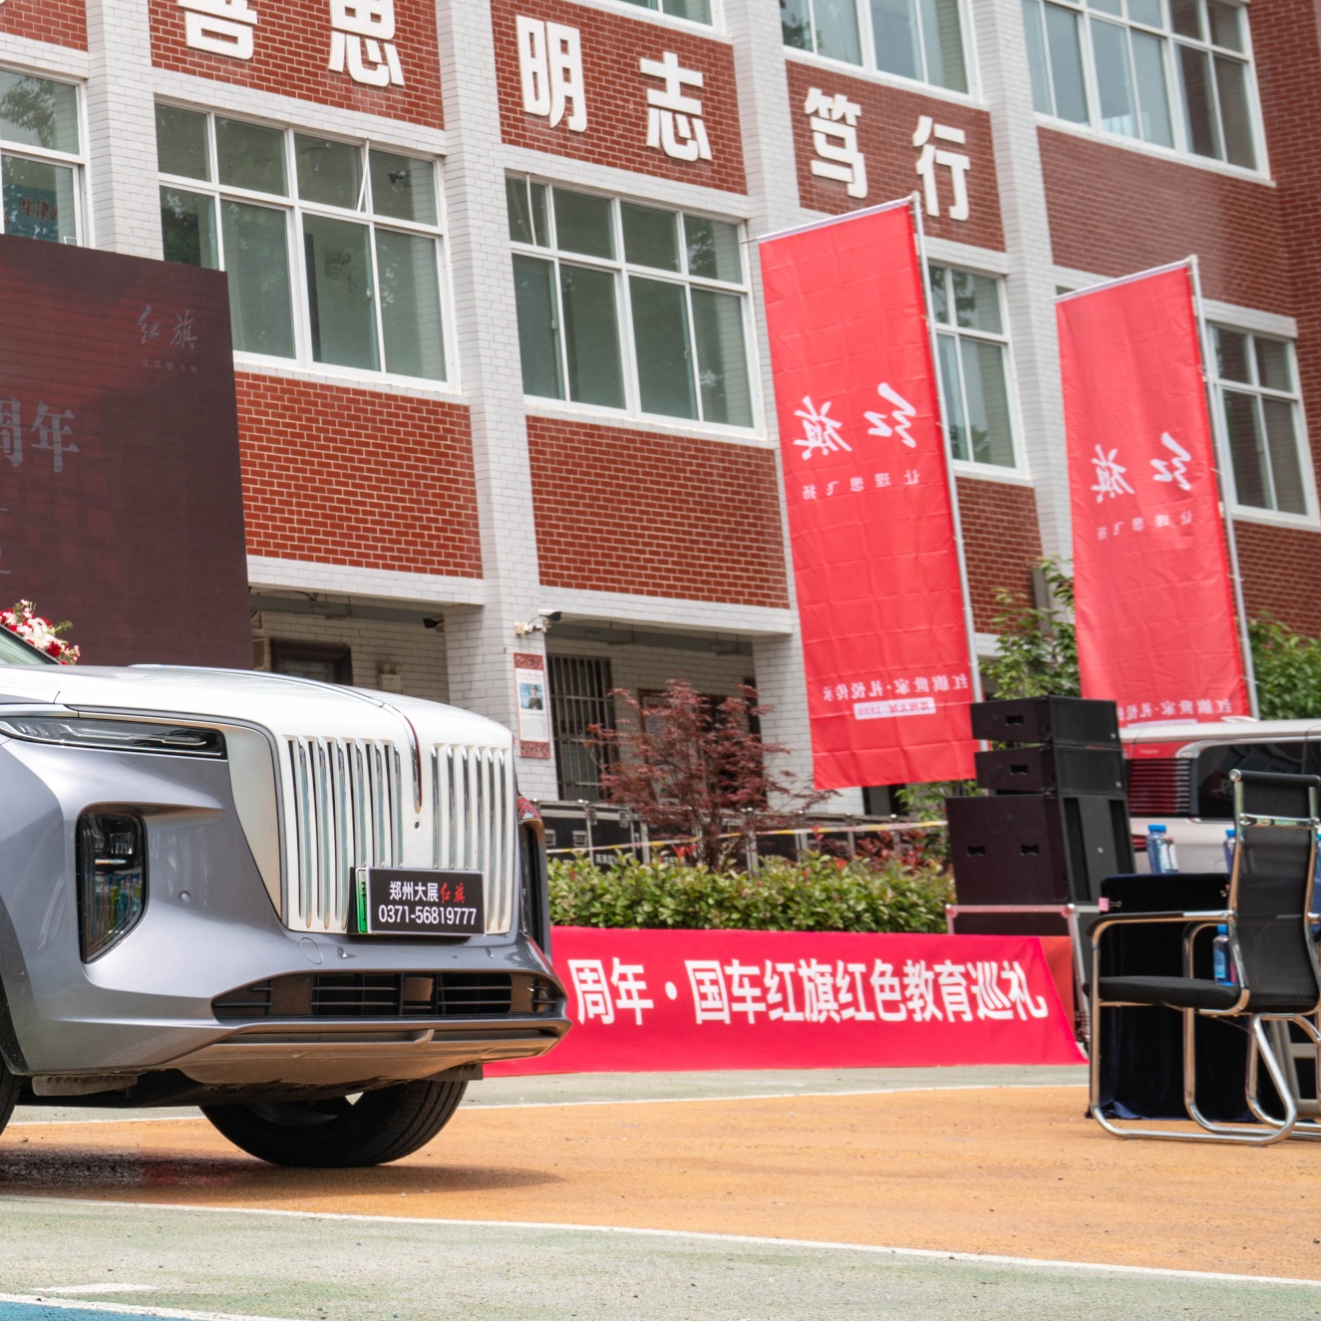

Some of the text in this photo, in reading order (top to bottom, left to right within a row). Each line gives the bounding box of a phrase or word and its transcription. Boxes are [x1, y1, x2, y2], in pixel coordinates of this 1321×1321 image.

[515, 14, 711, 163] 明志
[805, 89, 970, 223] 笃行
[378, 905, 477, 925] 0371-56819777
